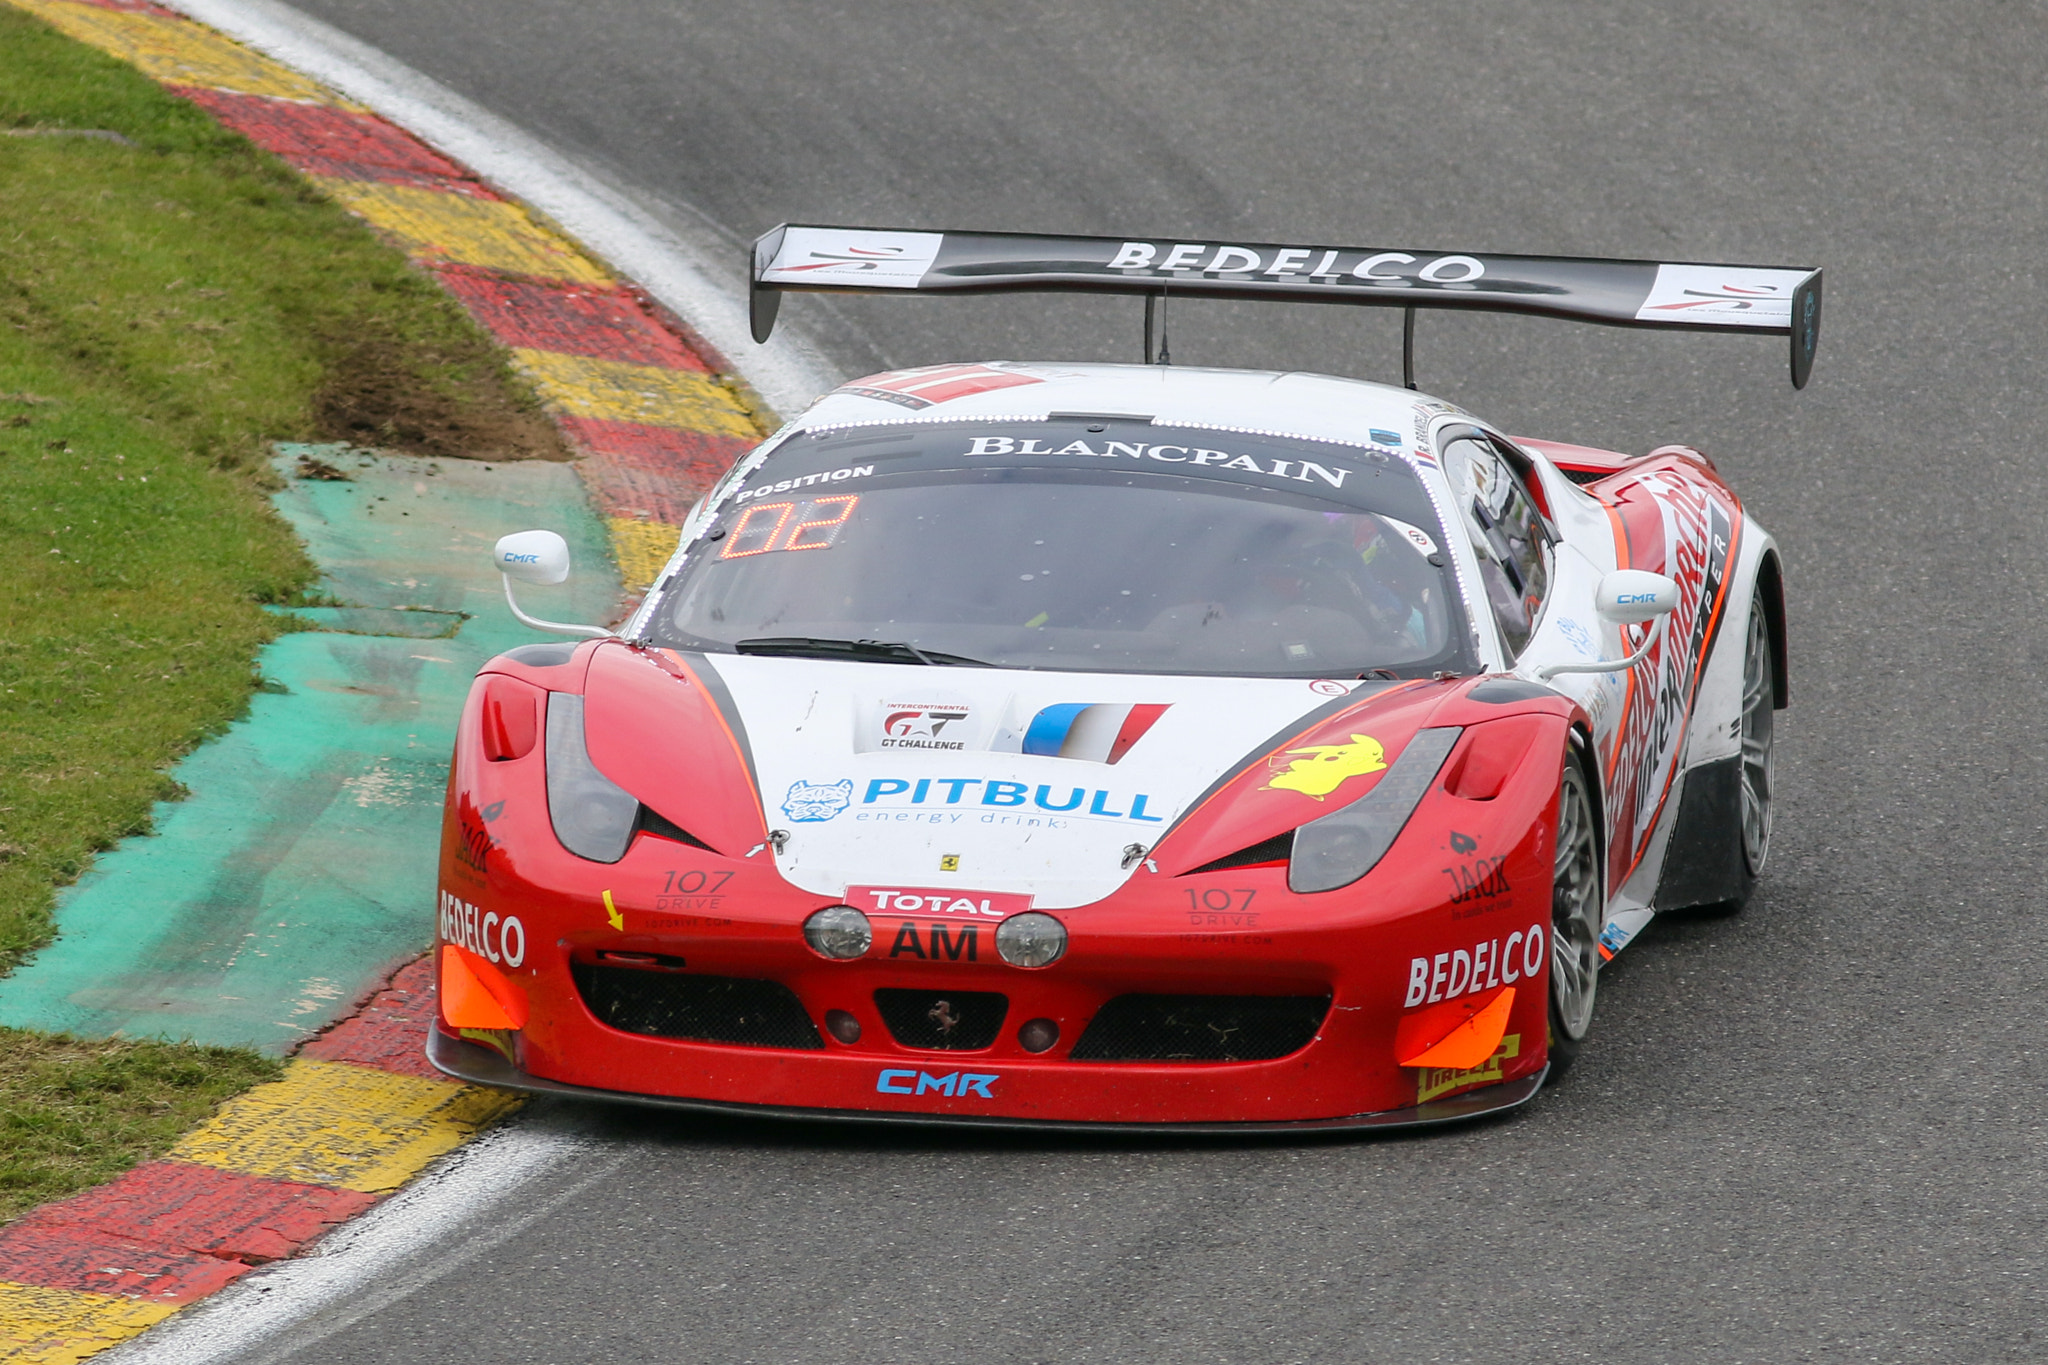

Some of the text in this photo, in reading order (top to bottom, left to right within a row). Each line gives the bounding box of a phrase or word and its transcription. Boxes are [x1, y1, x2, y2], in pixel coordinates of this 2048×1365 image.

[1107, 242, 1486, 283] BEDELCO
[964, 436, 1353, 489] BLANCPAIN
[735, 465, 875, 505] POSITION
[720, 494, 859, 559] 02
[504, 552, 541, 564] CMR
[1617, 593, 1657, 604] CMR
[887, 703, 971, 711] INTERCONTINENTAL
[881, 739, 965, 750] GT CHALLENGE
[862, 778, 1164, 823] PITBULL
[856, 811, 963, 824] energy
[664, 870, 735, 894] 107
[1442, 855, 1511, 904] JAQK
[656, 898, 721, 910] DRIVE
[869, 890, 1004, 916] TOTAL
[1184, 888, 1257, 911] 107
[441, 889, 525, 968] BEDELCO
[1190, 914, 1257, 927] DRIVE
[889, 922, 978, 962] AM
[1404, 923, 1544, 1008] BEDELCO
[876, 1068, 1000, 1098] CMR
